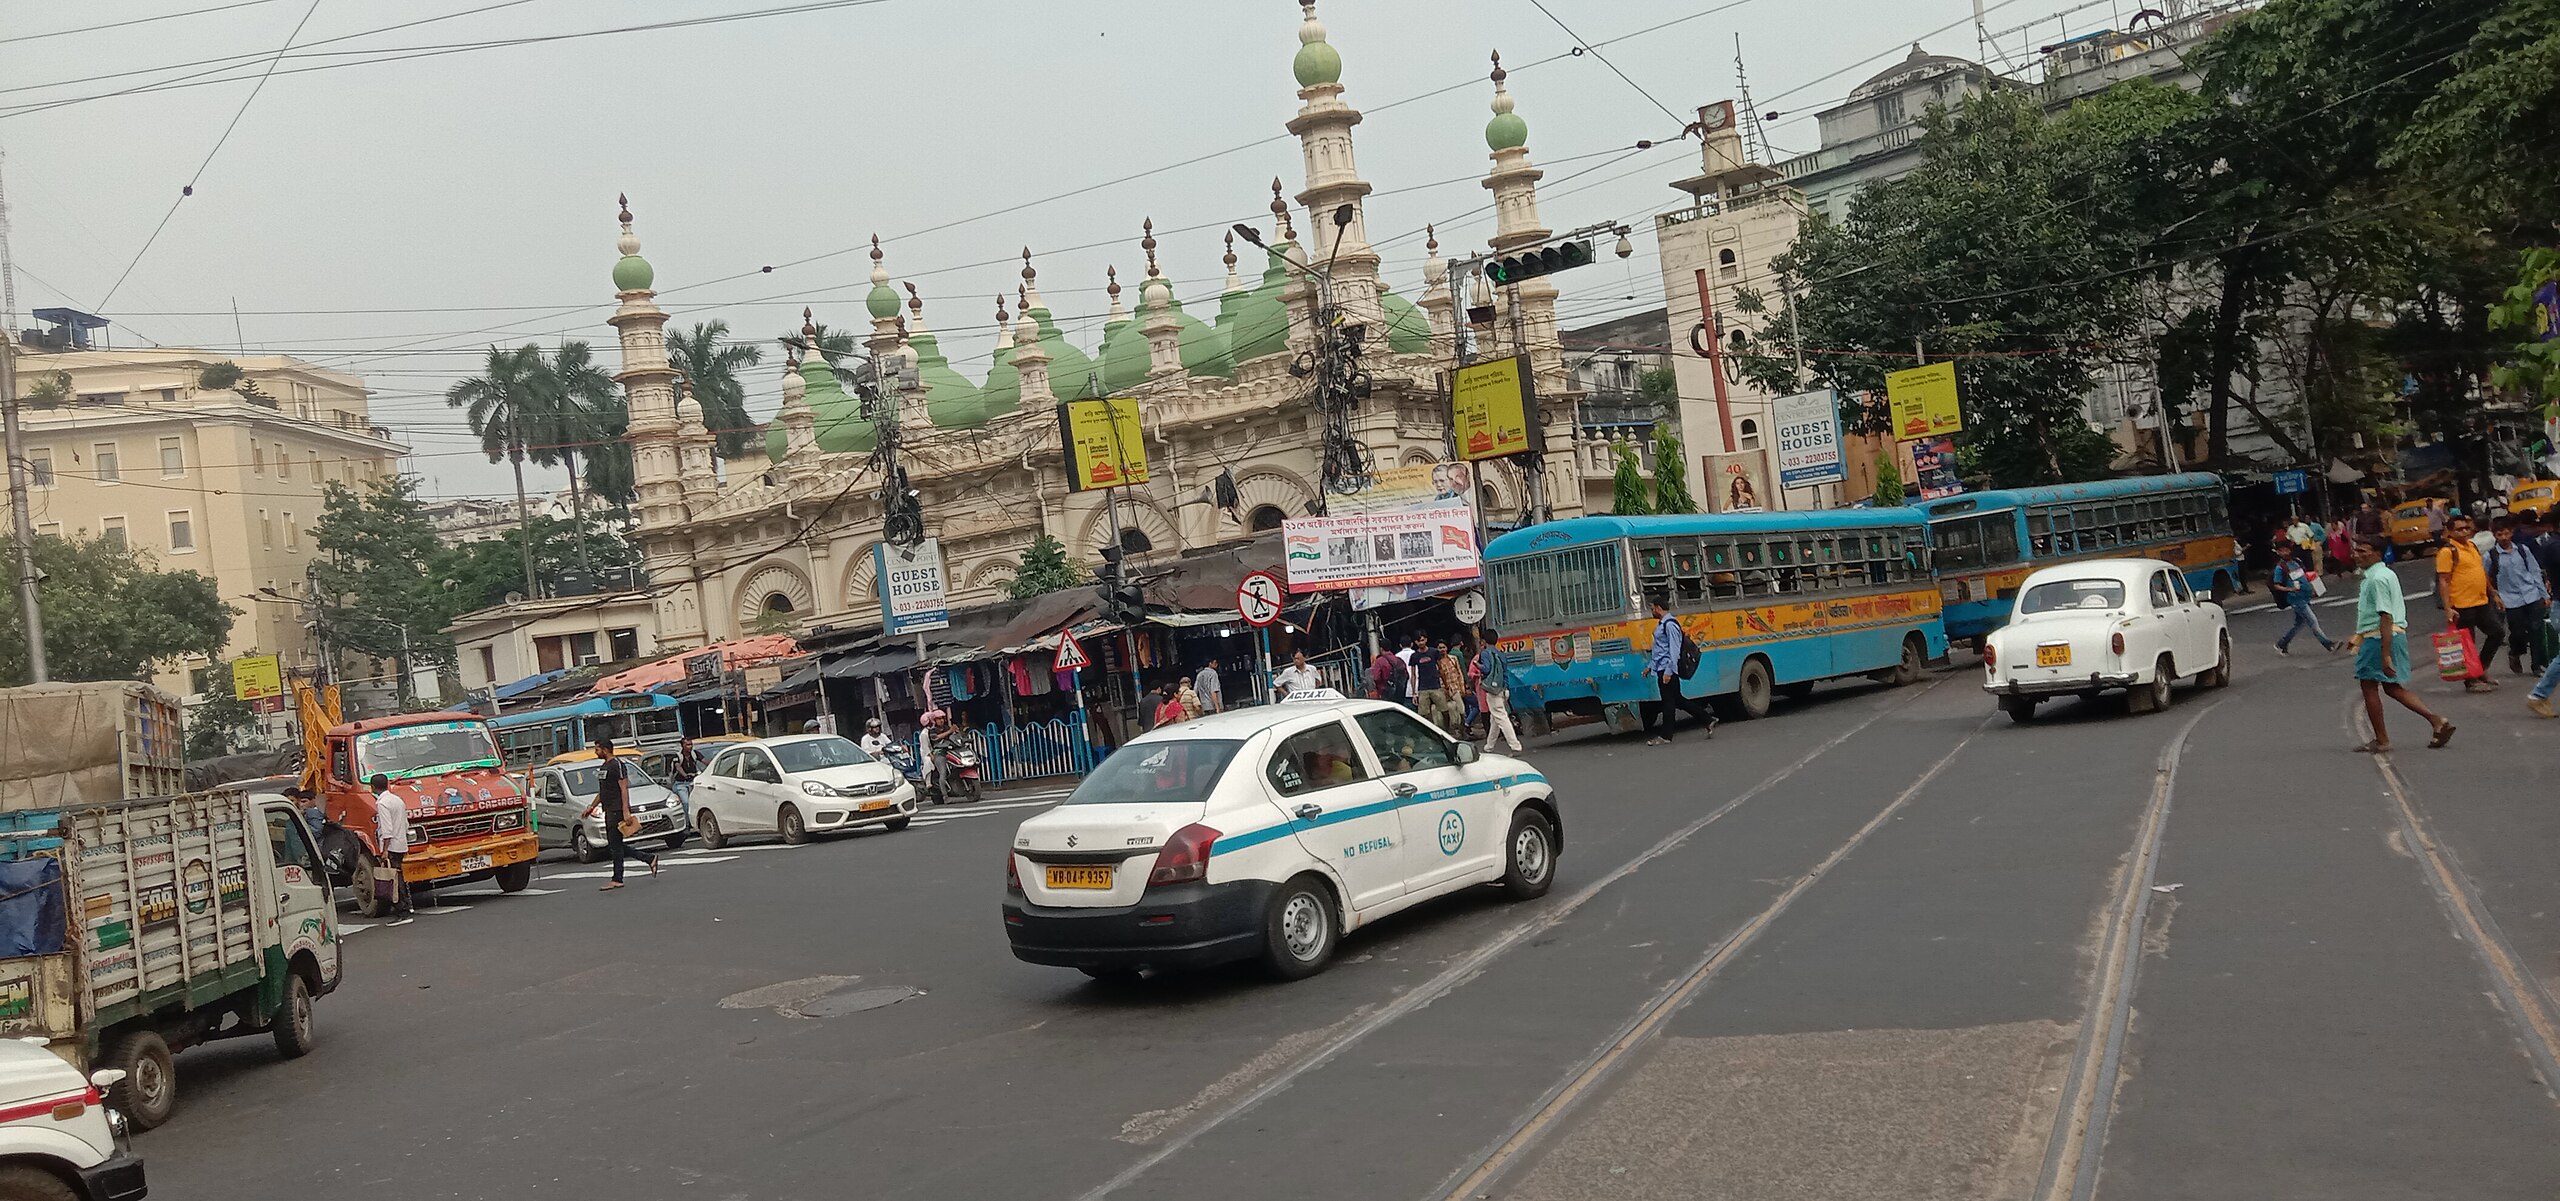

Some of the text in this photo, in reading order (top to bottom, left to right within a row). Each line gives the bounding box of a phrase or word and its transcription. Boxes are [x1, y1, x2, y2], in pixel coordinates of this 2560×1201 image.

[1781, 420, 1830, 438] GUEST
[1781, 433, 1833, 451] HOUSE
[1788, 457, 1800, 467] 033
[1805, 451, 1836, 464] 22303755
[1726, 464, 1741, 475] 40
[892, 567, 937, 583] GUEST
[892, 580, 940, 596] HOUSE
[899, 602, 912, 612] 033
[915, 598, 945, 610] 22303755
[1466, 599, 1473, 609] 1
[1500, 640, 1525, 653] STOP
[1445, 819, 1458, 831] AC
[1442, 832, 1461, 846] TAXI
[1343, 836, 1393, 859] NO REFUSAL
